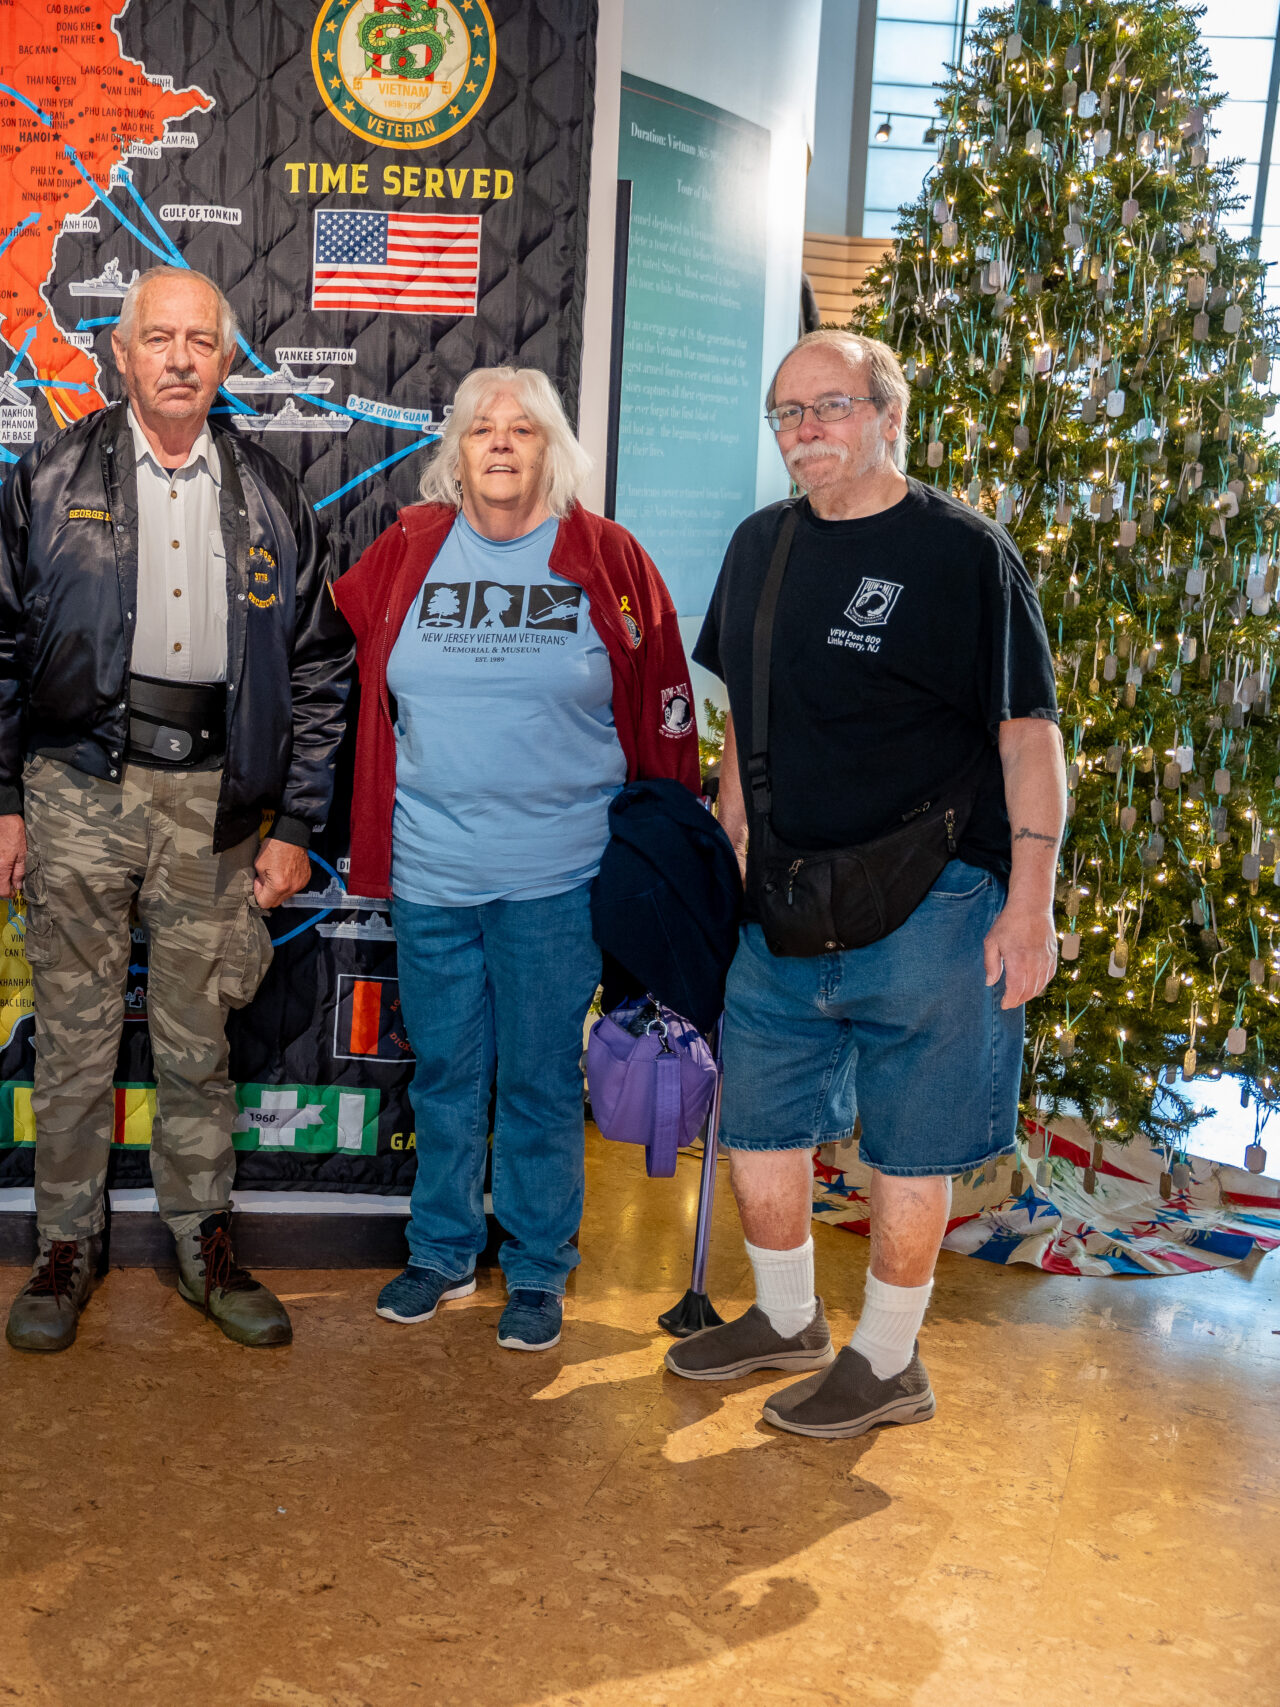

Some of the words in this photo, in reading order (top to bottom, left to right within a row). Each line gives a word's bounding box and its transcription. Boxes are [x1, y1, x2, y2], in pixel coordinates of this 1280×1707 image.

[47, 4, 61, 14] CAO
[64, 4, 85, 14] BANG
[57, 22, 78, 31] DONG
[81, 22, 95, 31] KHE
[60, 35, 78, 44] THAT
[81, 35, 95, 44] KHE
[19, 46, 33, 55] BAC
[36, 46, 51, 54] KAN
[81, 66, 100, 75] LANG
[103, 66, 118, 75] SON
[26, 76, 43, 85] THAI
[46, 76, 76, 85] NGUYEN
[152, 78, 170, 87] BINH
[107, 86, 122, 95] VAN
[124, 87, 142, 96] LINH
[378, 83, 429, 98] VIETNAM
[39, 99, 56, 107] VINH
[58, 99, 73, 107] YEN
[85, 108, 99, 116] PHU
[102, 108, 121, 118] LANG
[1, 118, 16, 127] SON
[18, 119, 31, 127] TAY
[50, 120, 68, 129] NINH
[368, 116, 436, 138] VETERAN
[121, 122, 137, 131] MAO
[140, 124, 154, 133] KHE
[20, 132, 51, 142] HANOI
[95, 133, 108, 142] HAI
[162, 136, 178, 144] CAM
[180, 136, 195, 145] PHA
[631, 122, 666, 146] Duration:
[668, 133, 696, 156] Vietnam
[56, 152, 77, 160] HUNG
[79, 152, 94, 160] YEN
[31, 167, 45, 175] PHU
[48, 167, 56, 175] LY
[38, 178, 55, 187] NAM
[57, 178, 76, 187] DINH
[92, 174, 109, 182] THAI
[111, 174, 129, 183] BINH
[285, 163, 369, 194] TIME
[383, 165, 514, 200] SERVED
[677, 178, 693, 196] Tour
[22, 193, 41, 201] NINH
[43, 192, 61, 201] BINH
[162, 208, 186, 219] GULF
[189, 208, 200, 219] OF
[203, 208, 239, 223] TONKIN
[54, 220, 80, 229] THANH
[82, 221, 97, 229] HOA
[10, 228, 40, 237] THUONG
[16, 308, 34, 317] VINH
[74, 336, 91, 345] TINH
[278, 351, 313, 362] YANKEE
[316, 351, 354, 362] STATION
[1, 408, 34, 418] NAKHON
[376, 405, 401, 420] FROM
[403, 410, 430, 423] GUAM
[1, 420, 35, 429] PHANOM
[2, 431, 11, 441] AF
[13, 431, 32, 441] BASE
[69, 509, 105, 520] GEORGE
[421, 633, 443, 642] NEW
[444, 633, 475, 644] JERSEY
[477, 633, 517, 644] VIETNAM
[519, 632, 568, 646] VETERANS'
[830, 628, 847, 638] VFW
[847, 631, 864, 641] Post
[865, 635, 881, 645] 809
[827, 636, 844, 646] Little
[844, 639, 865, 652] Ferry,
[867, 644, 880, 653] NJ
[442, 646, 490, 654] MEMORIAL
[501, 646, 541, 654] MUSEUM
[11, 934, 24, 942] VIN
[4, 949, 19, 957] CAN
[0, 979, 23, 987] KHANH
[0, 999, 13, 1007] BAC
[16, 999, 31, 1007] LIEU
[249, 1113, 280, 1123] 1960-
